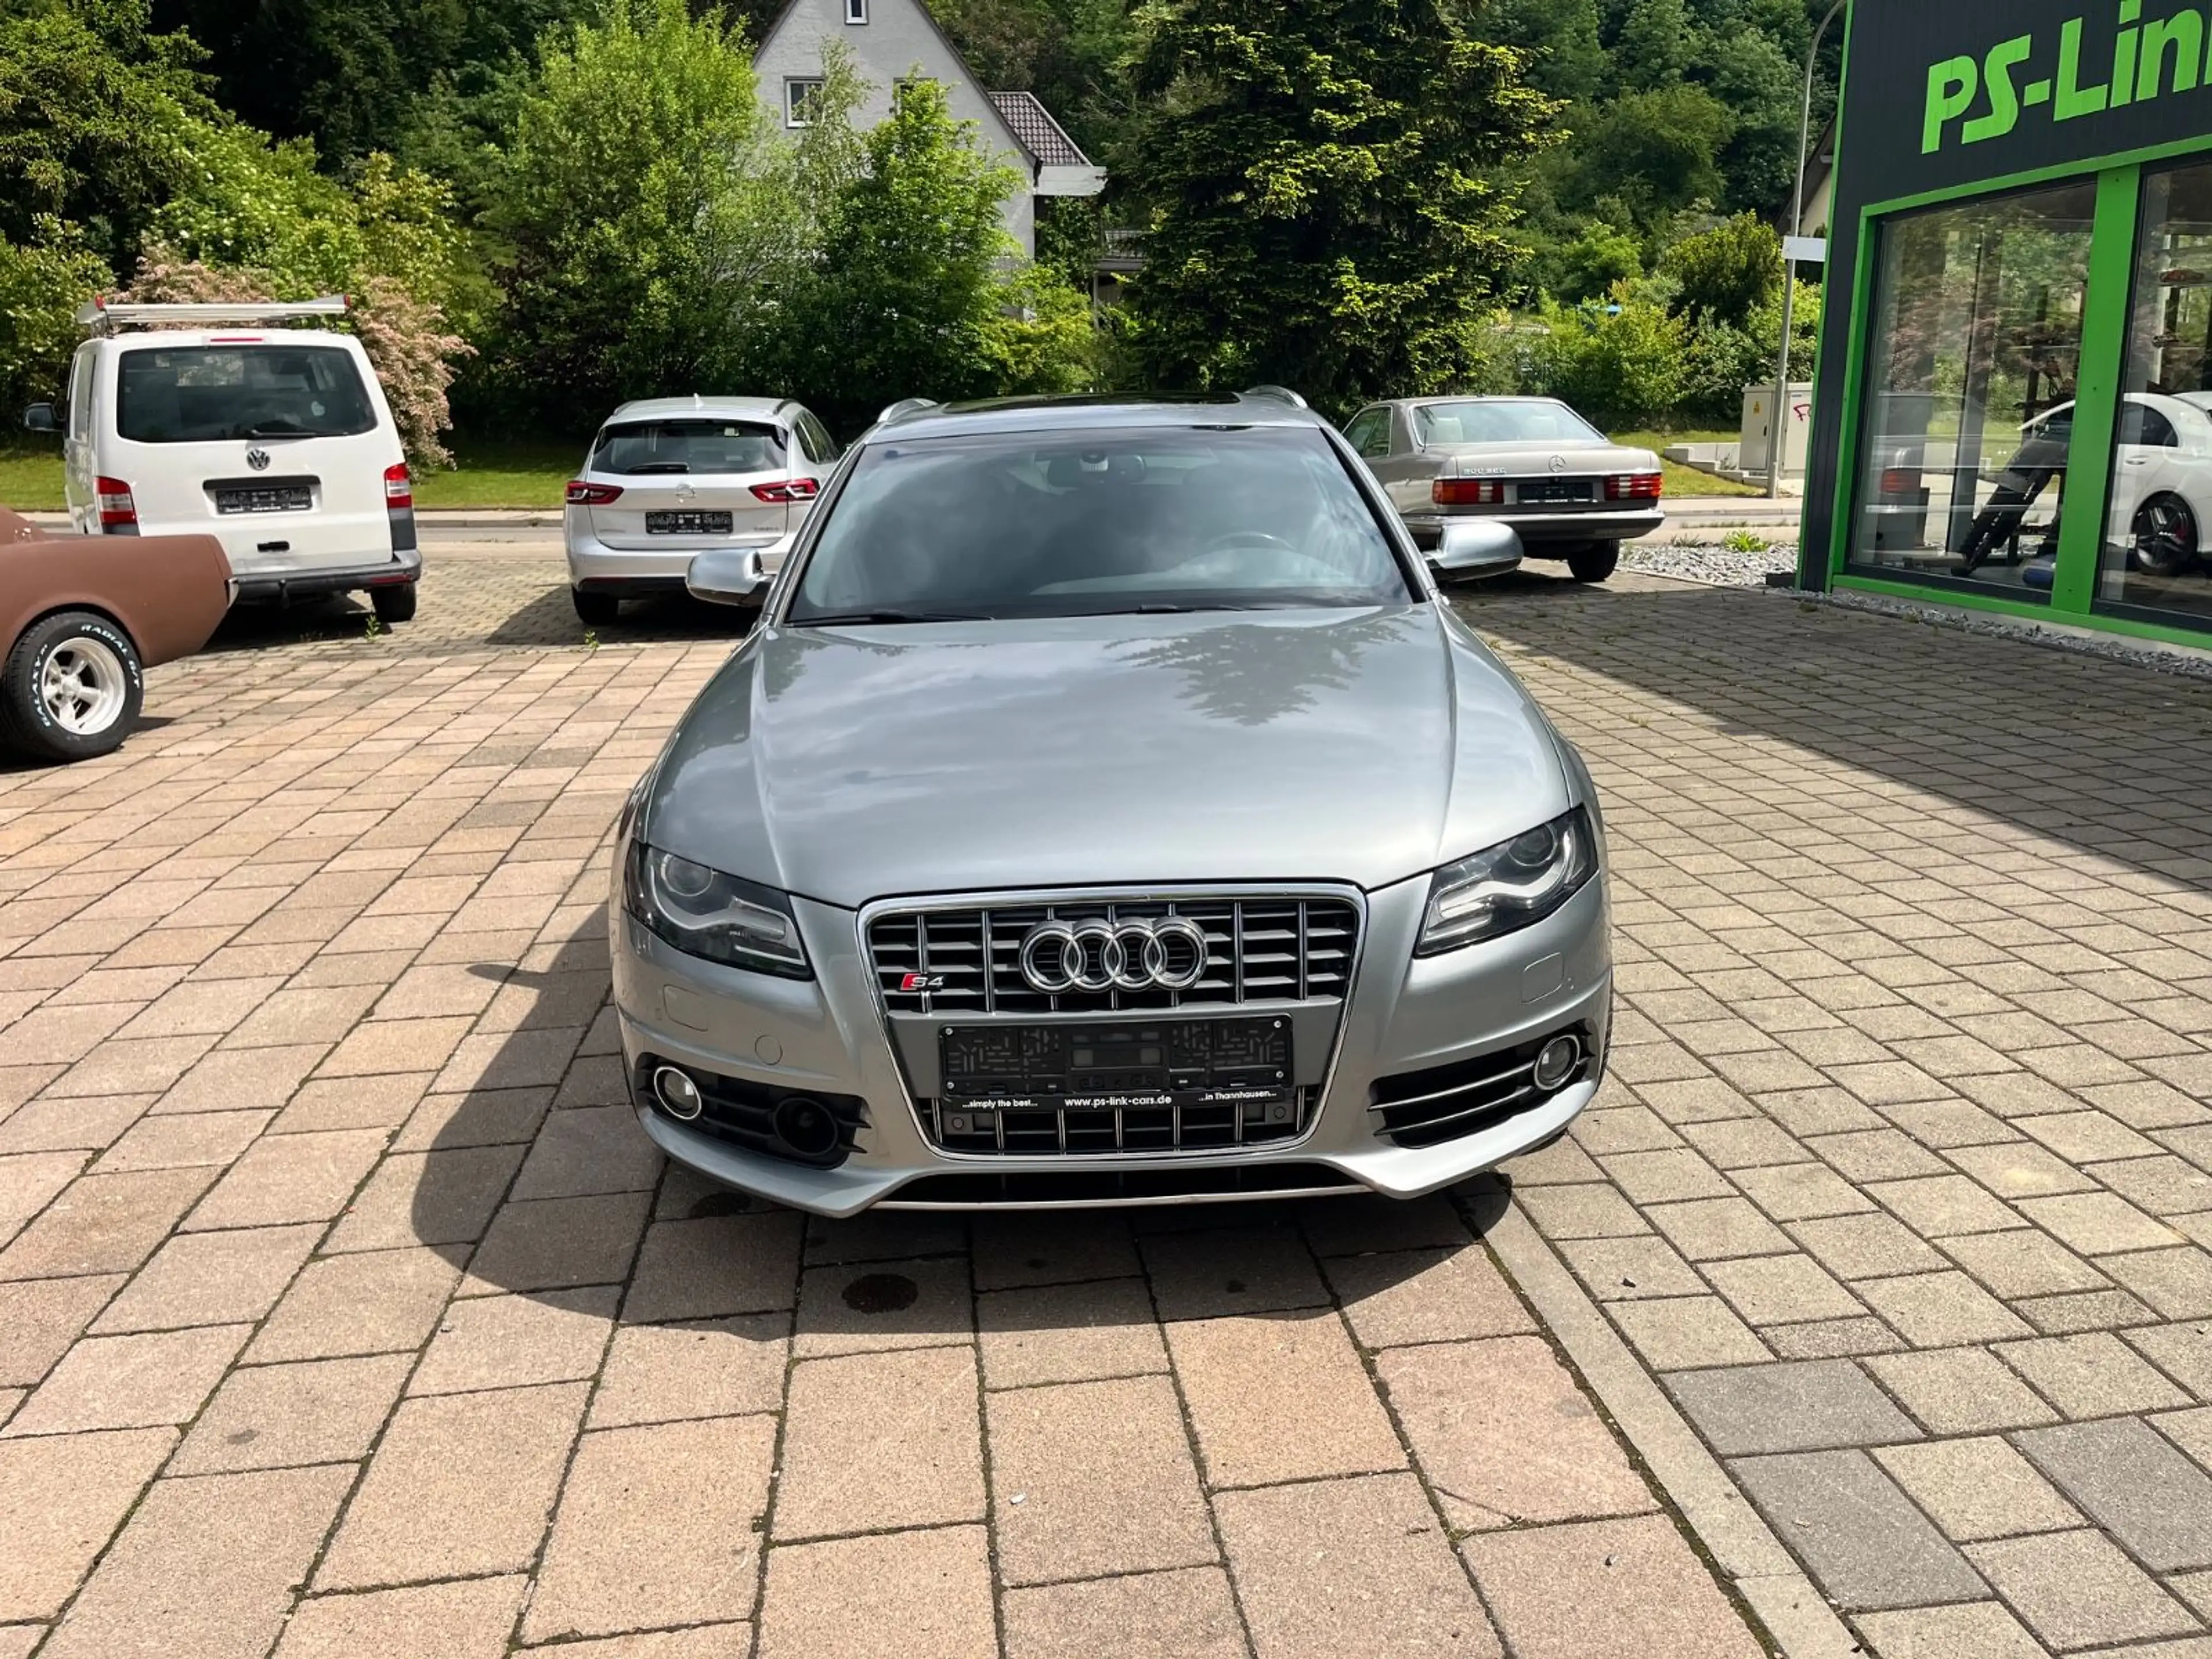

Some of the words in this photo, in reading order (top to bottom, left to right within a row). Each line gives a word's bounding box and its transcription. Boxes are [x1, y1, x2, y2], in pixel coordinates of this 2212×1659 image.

[1922, 0, 2212, 154] PS-Lin
[81, 624, 128, 656] RADIAL
[910, 975, 944, 988] S4
[1065, 1095, 1172, 1107] www.ps-link-cars.de
